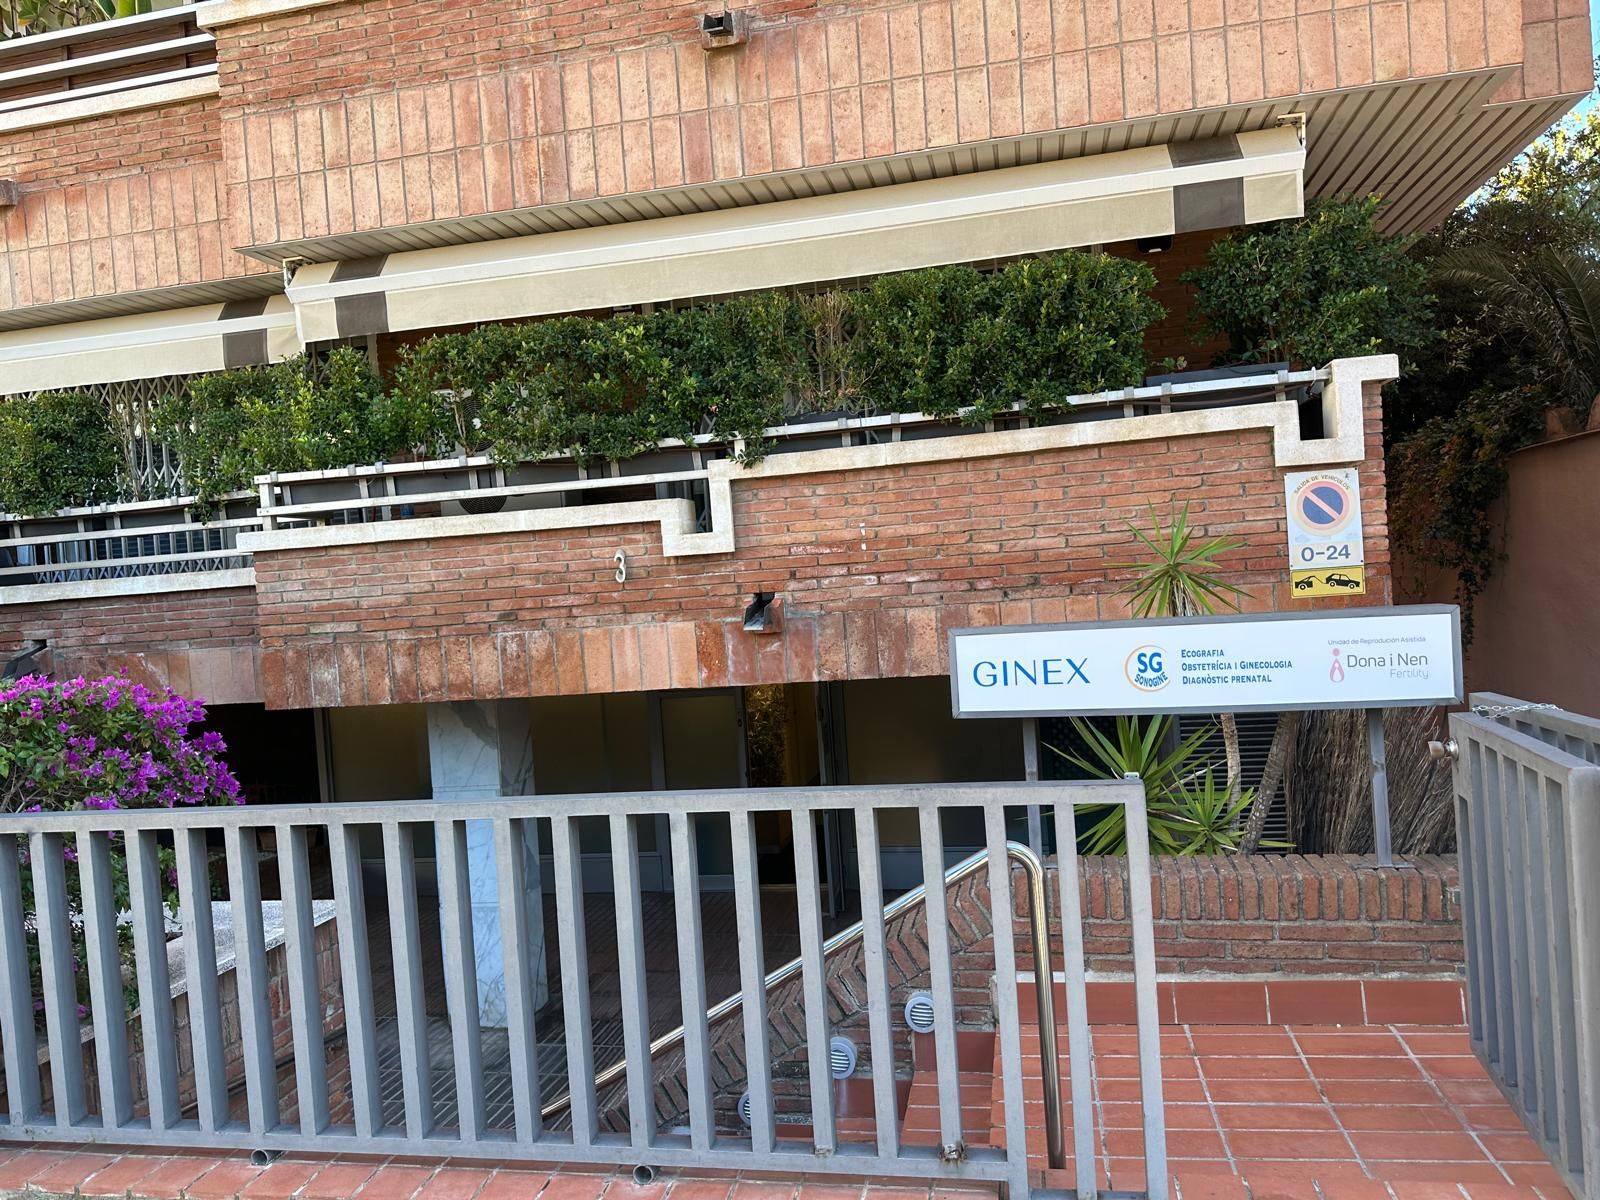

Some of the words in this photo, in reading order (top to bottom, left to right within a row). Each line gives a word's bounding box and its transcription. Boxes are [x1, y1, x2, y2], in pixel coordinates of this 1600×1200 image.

[1301, 544, 1351, 562] 0-24
[614, 549, 626, 583] 3
[1137, 652, 1163, 673] SG
[1347, 654, 1386, 668] Dona
[1389, 653, 1393, 667] i
[1397, 653, 1428, 666] Nen
[973, 657, 1091, 688] GINEX
[1134, 671, 1169, 688] SONOGINE
[1390, 668, 1429, 680] Fertility
